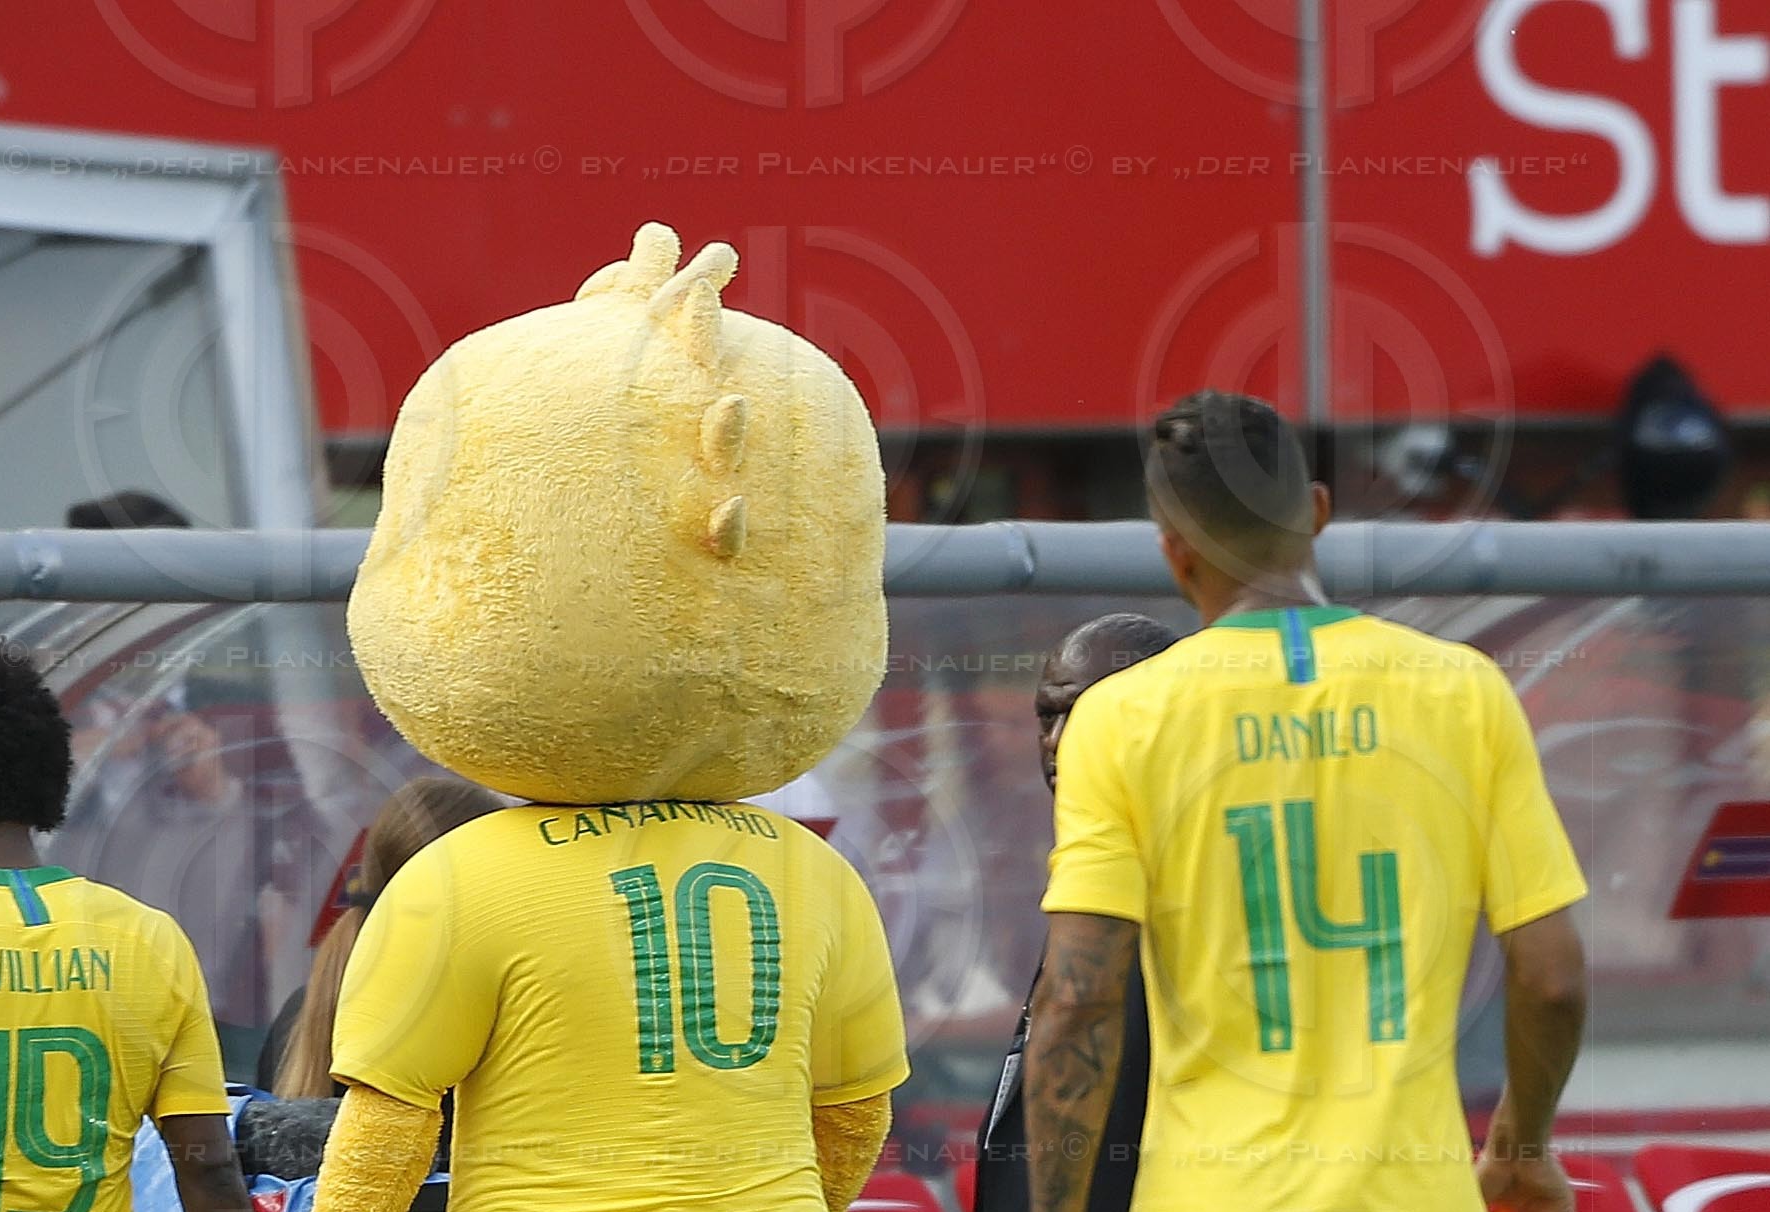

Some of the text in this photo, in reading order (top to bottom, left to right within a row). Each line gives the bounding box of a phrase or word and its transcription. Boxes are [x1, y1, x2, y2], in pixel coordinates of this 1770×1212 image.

[1466, 0, 1770, 257] St
[1236, 706, 1379, 763] DANILO
[609, 861, 782, 1073] 10
[1224, 800, 1407, 1053] 14
